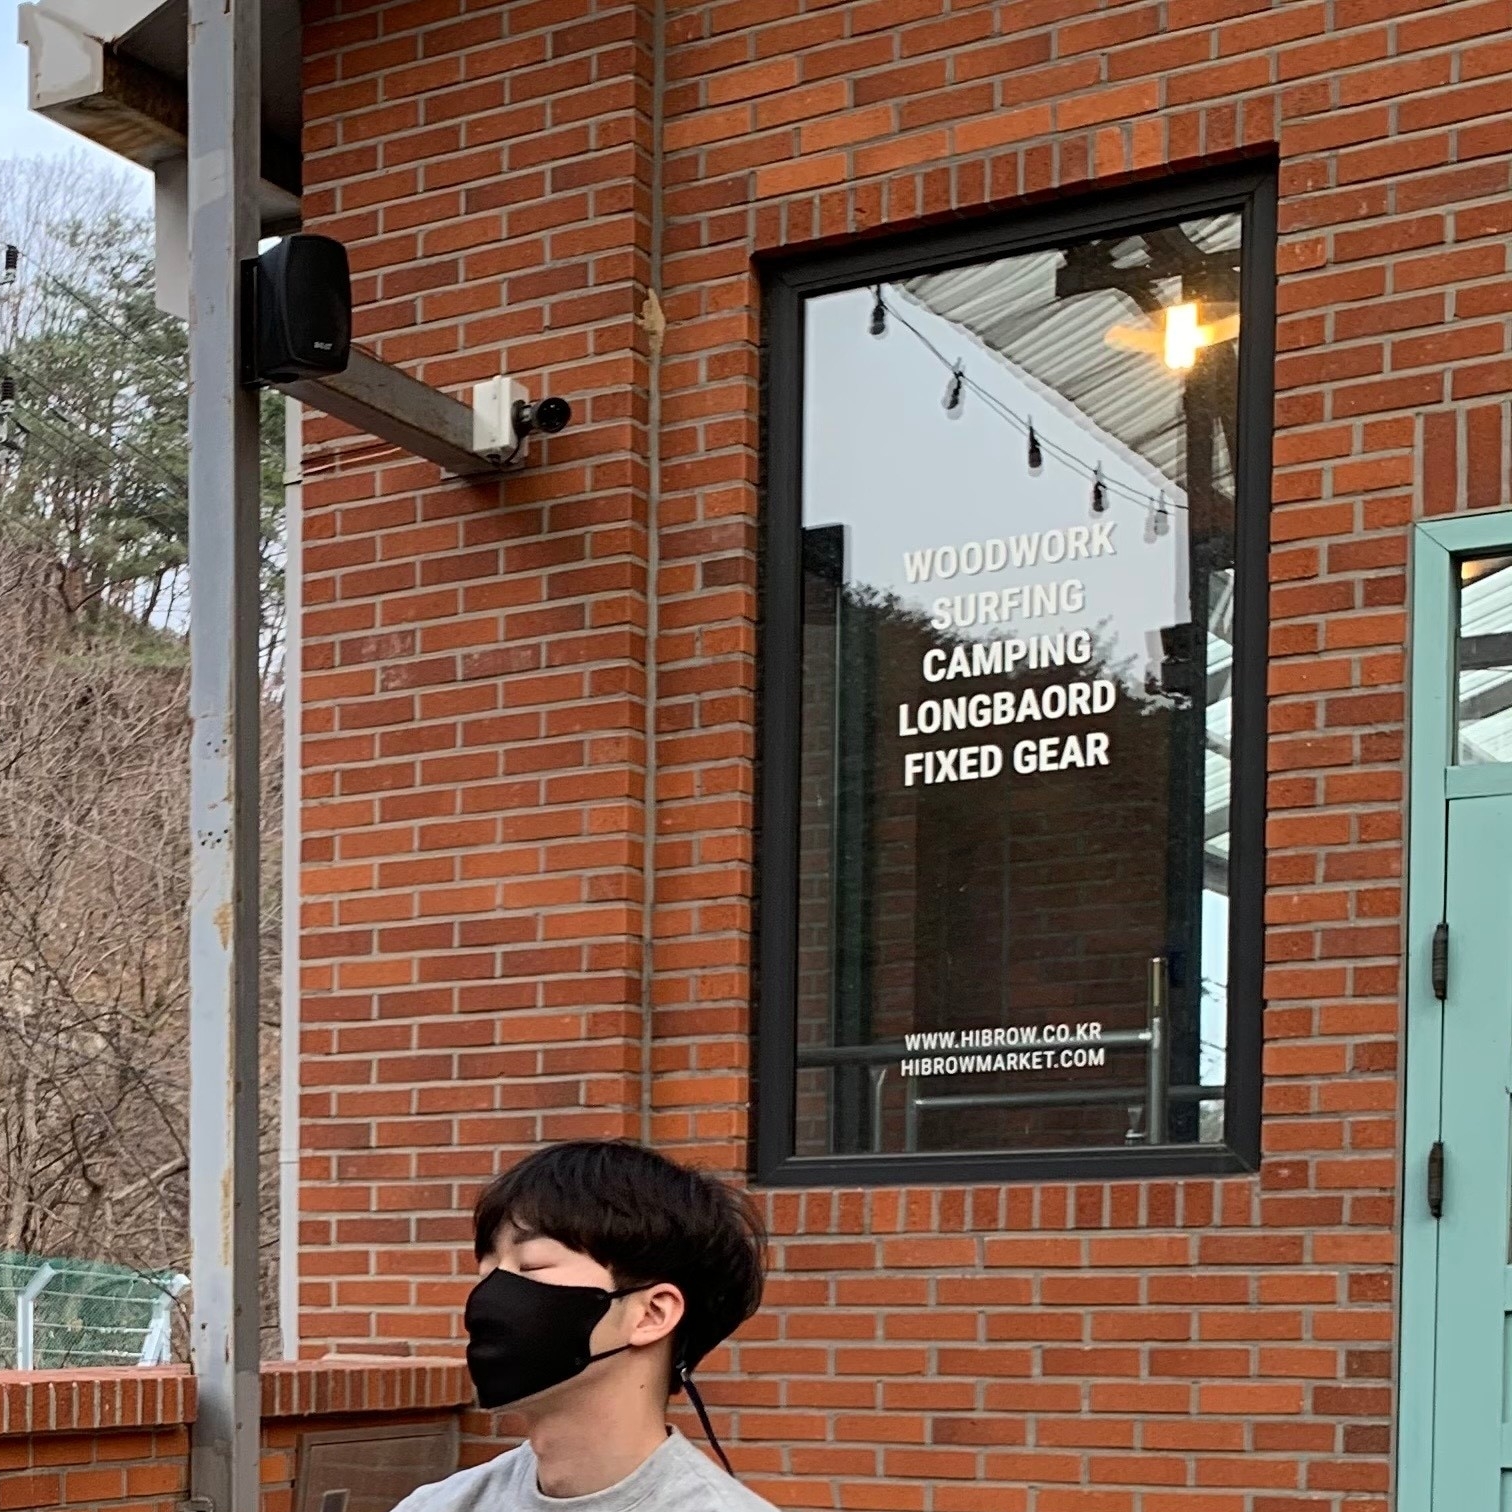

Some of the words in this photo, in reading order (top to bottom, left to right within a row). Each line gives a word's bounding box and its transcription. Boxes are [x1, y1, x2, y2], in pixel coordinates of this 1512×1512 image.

[903, 521, 1116, 583] WOODWORK
[930, 578, 1085, 629] SURFING
[923, 630, 1091, 682] CAMPING
[899, 680, 1116, 736] LONGBAORD
[904, 744, 1003, 786] FIXED
[1012, 732, 1110, 774] GEAR
[900, 1048, 1105, 1077] HIBROWMARKET.COM
[904, 1022, 1102, 1051] WWW.HIBROW.CO.KR
